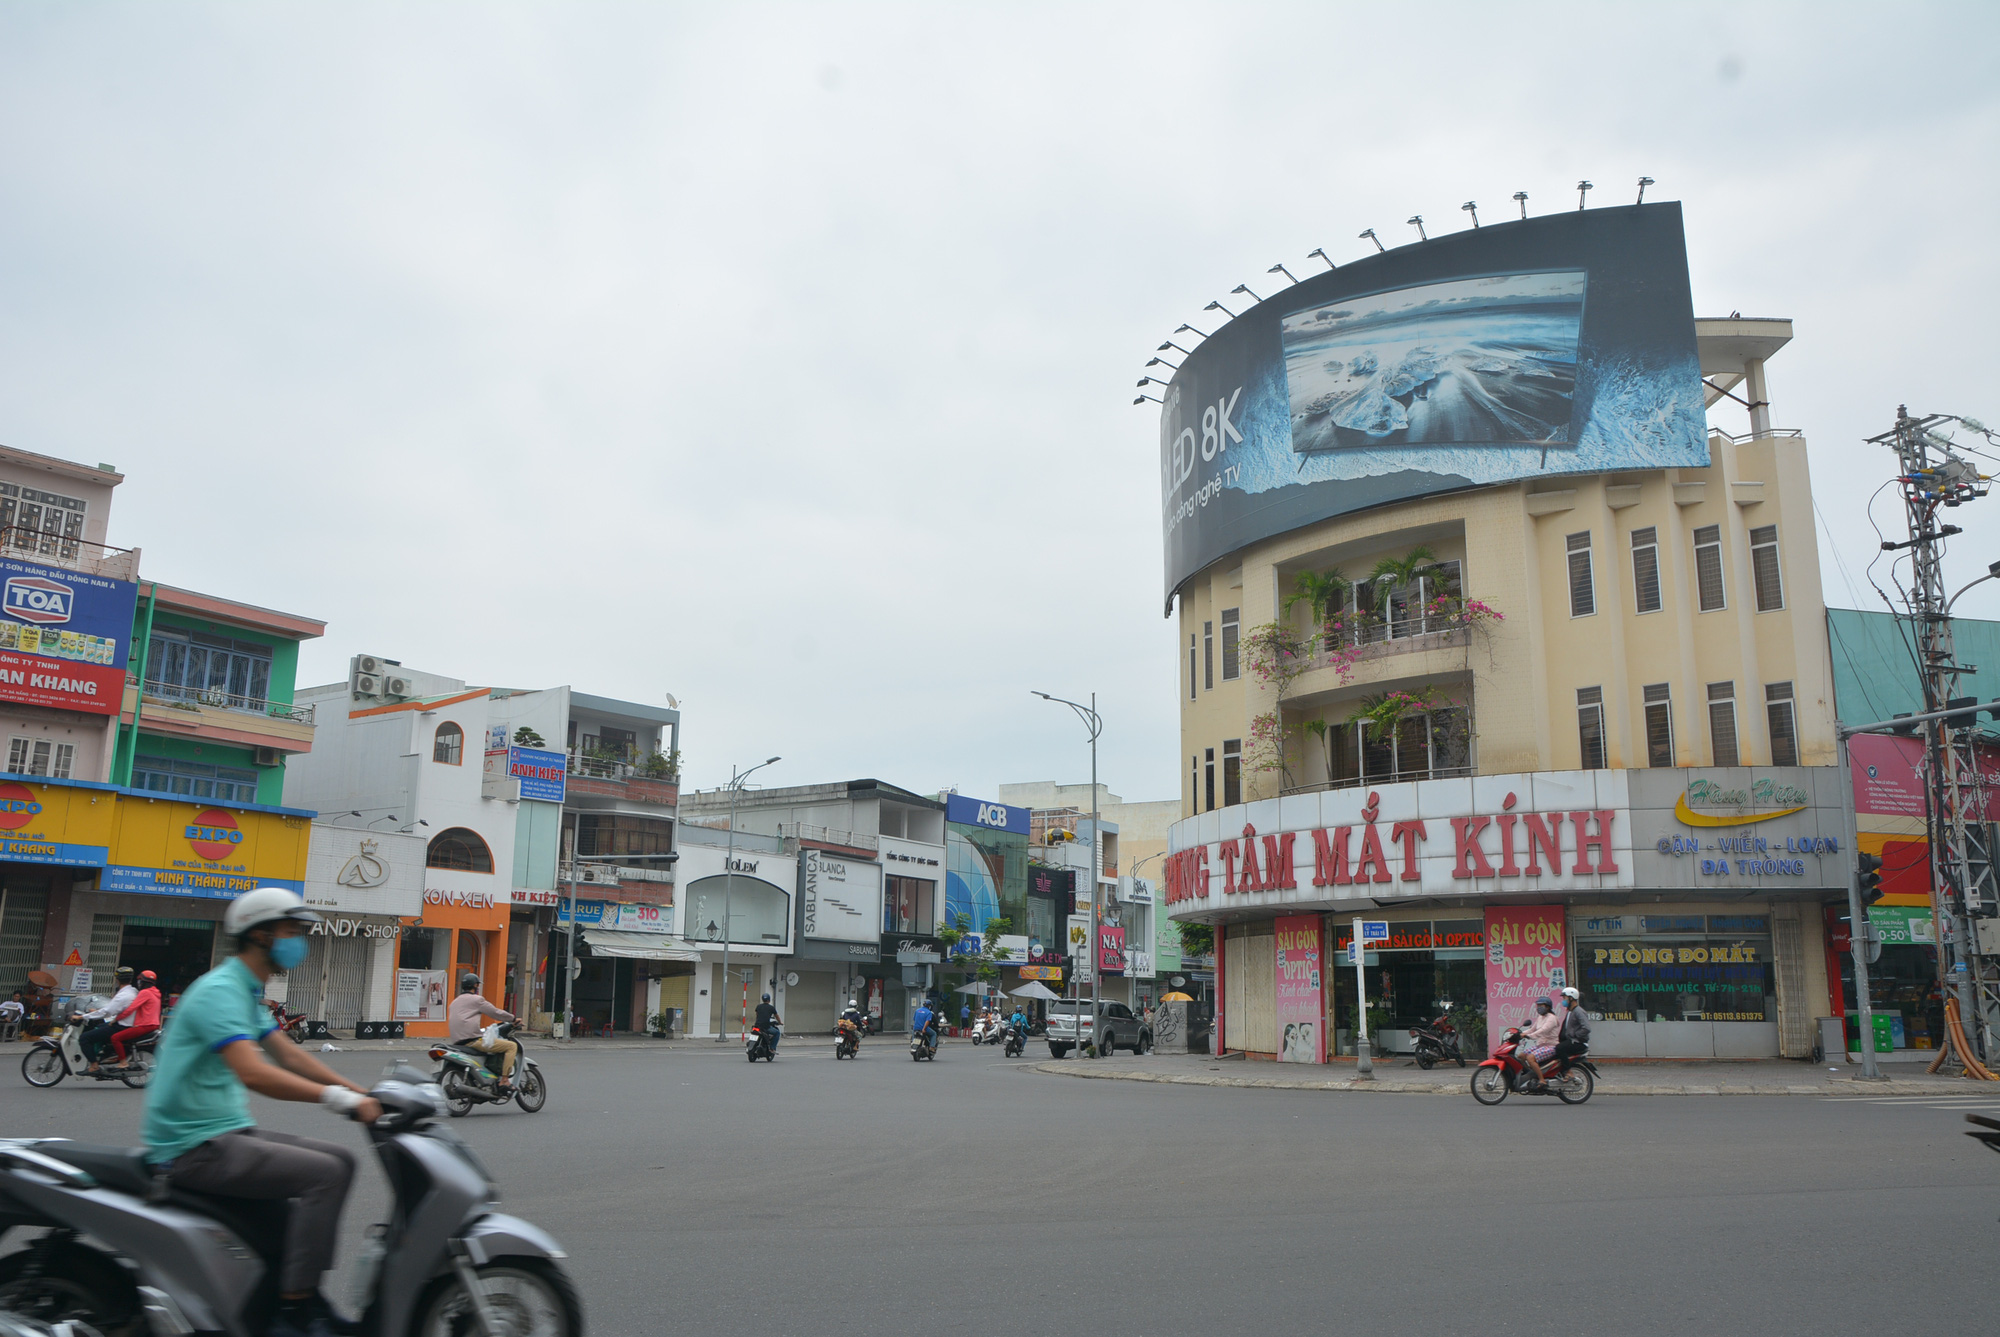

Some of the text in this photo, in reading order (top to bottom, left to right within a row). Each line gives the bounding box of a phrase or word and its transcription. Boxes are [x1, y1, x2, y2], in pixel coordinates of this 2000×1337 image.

[1201, 386, 1244, 462] 8K
[1195, 472, 1222, 508] nghệ
[1224, 462, 1242, 487] TV
[90, 579, 108, 588] NAM
[12, 586, 65, 613] TOA
[24, 628, 39, 636] TOA
[43, 631, 58, 639] TOA
[22, 658, 33, 666] TY
[36, 660, 60, 671] TNHH
[0, 668, 98, 696] AN KHANG
[510, 762, 565, 783] ANH KIỆT
[1689, 777, 1809, 813] Hàng Hiệu
[976, 802, 1007, 827] ACB
[184, 825, 244, 844] EXPO
[1219, 822, 1298, 894] TÂM
[1311, 791, 1428, 887] MẮT
[1450, 791, 1619, 879] KÍNH
[8, 842, 56, 856] KHANG
[1657, 833, 1700, 858] CẬN
[1787, 836, 1839, 859] LOẠN
[1702, 853, 1805, 876] ĐA TRÒNG
[154, 871, 259, 891] MINH THÀNH PHÁT
[460, 890, 495, 910] XEN
[529, 892, 559, 906] KIỆT
[804, 852, 818, 934] SABLANCA
[637, 906, 659, 921] 310
[309, 918, 400, 939] ANDY SHOP
[1278, 924, 1318, 951] SÀI GÒN
[1394, 929, 1414, 948] SÀI
[1416, 928, 1443, 947] GÒN
[1446, 932, 1484, 946] OPTIC
[1490, 916, 1562, 945] SÀI GÒN
[1878, 929, 1910, 941] 0-50%
[848, 944, 878, 956] SABLANCA
[950, 935, 982, 957] ACB
[1102, 933, 1118, 950] NA
[1054, 953, 1062, 964] TX
[1104, 952, 1120, 968] Shop
[1594, 943, 1675, 965] PHÒNG
[1678, 947, 1709, 964] ĐO
[1710, 940, 1756, 964] MẮT
[1283, 959, 1313, 981] OPTIC
[1501, 956, 1554, 979] OPTIC
[1278, 982, 1296, 998] Kính
[1490, 981, 1552, 999] Kính chào
[1592, 981, 1618, 993] THỜI
[1623, 982, 1650, 993] GIAN
[1652, 981, 1675, 993] LÀM
[1676, 981, 1700, 994] VIỆC
[1498, 1003, 1527, 1024] Quý
[1587, 1012, 1601, 1020] 142
[1713, 1012, 1763, 1021] 05113.651375
